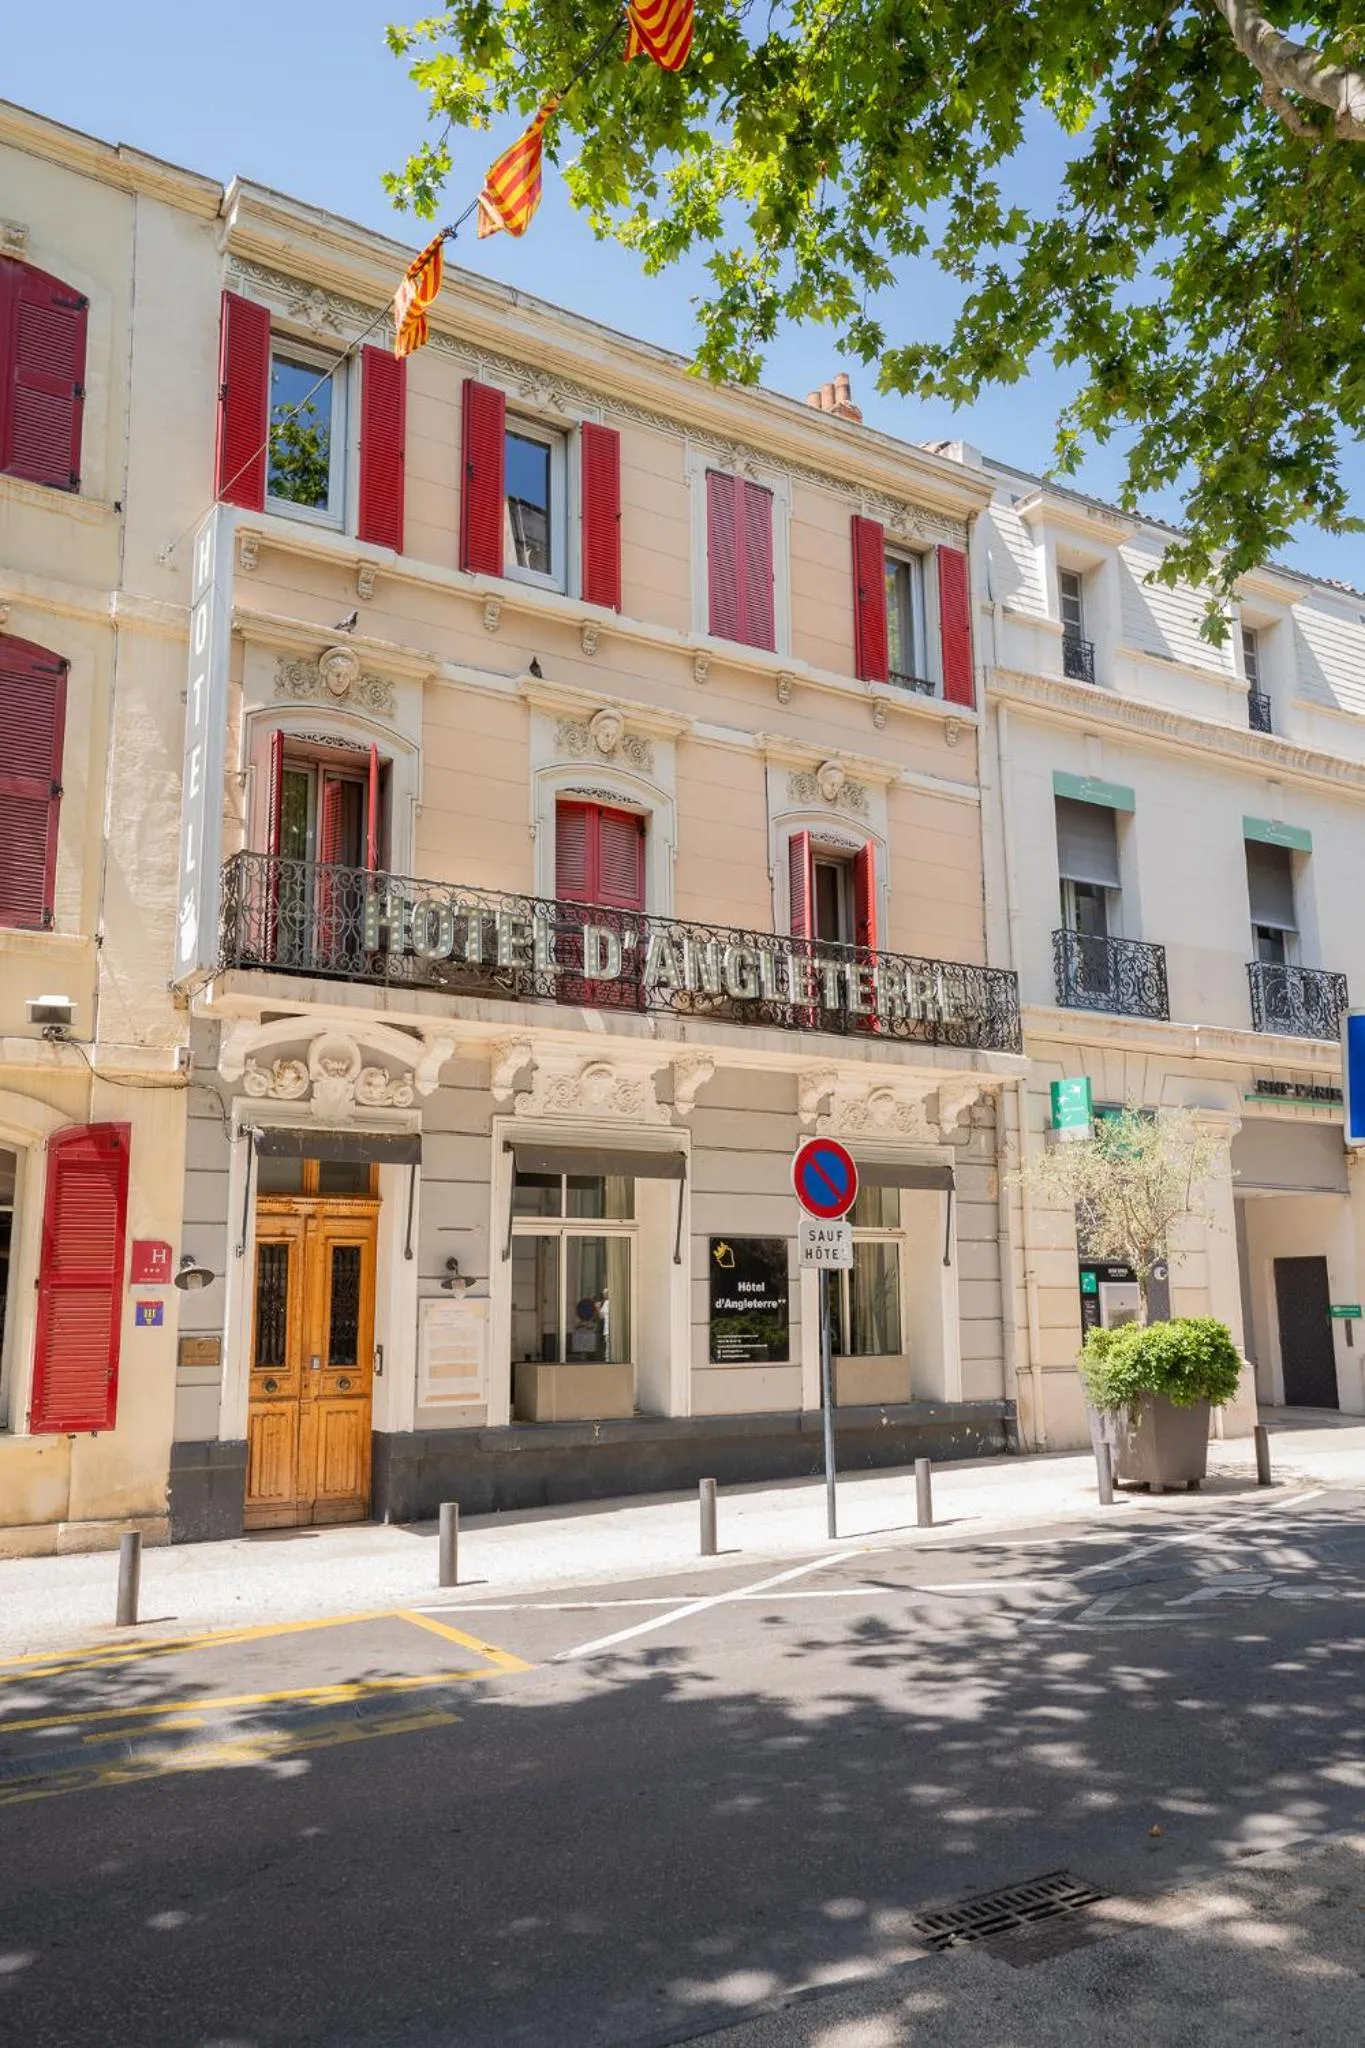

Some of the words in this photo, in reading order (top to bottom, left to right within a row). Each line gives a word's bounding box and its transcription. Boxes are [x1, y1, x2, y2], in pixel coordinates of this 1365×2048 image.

[185, 529, 212, 874] HOTEL
[361, 892, 564, 974] HOTEL
[583, 922, 970, 1027] D'ANGLETERRE
[808, 1229, 843, 1242] SAUF
[152, 1248, 166, 1264] H
[805, 1246, 848, 1261] HÔTE
[737, 1281, 766, 1293] Hôtel
